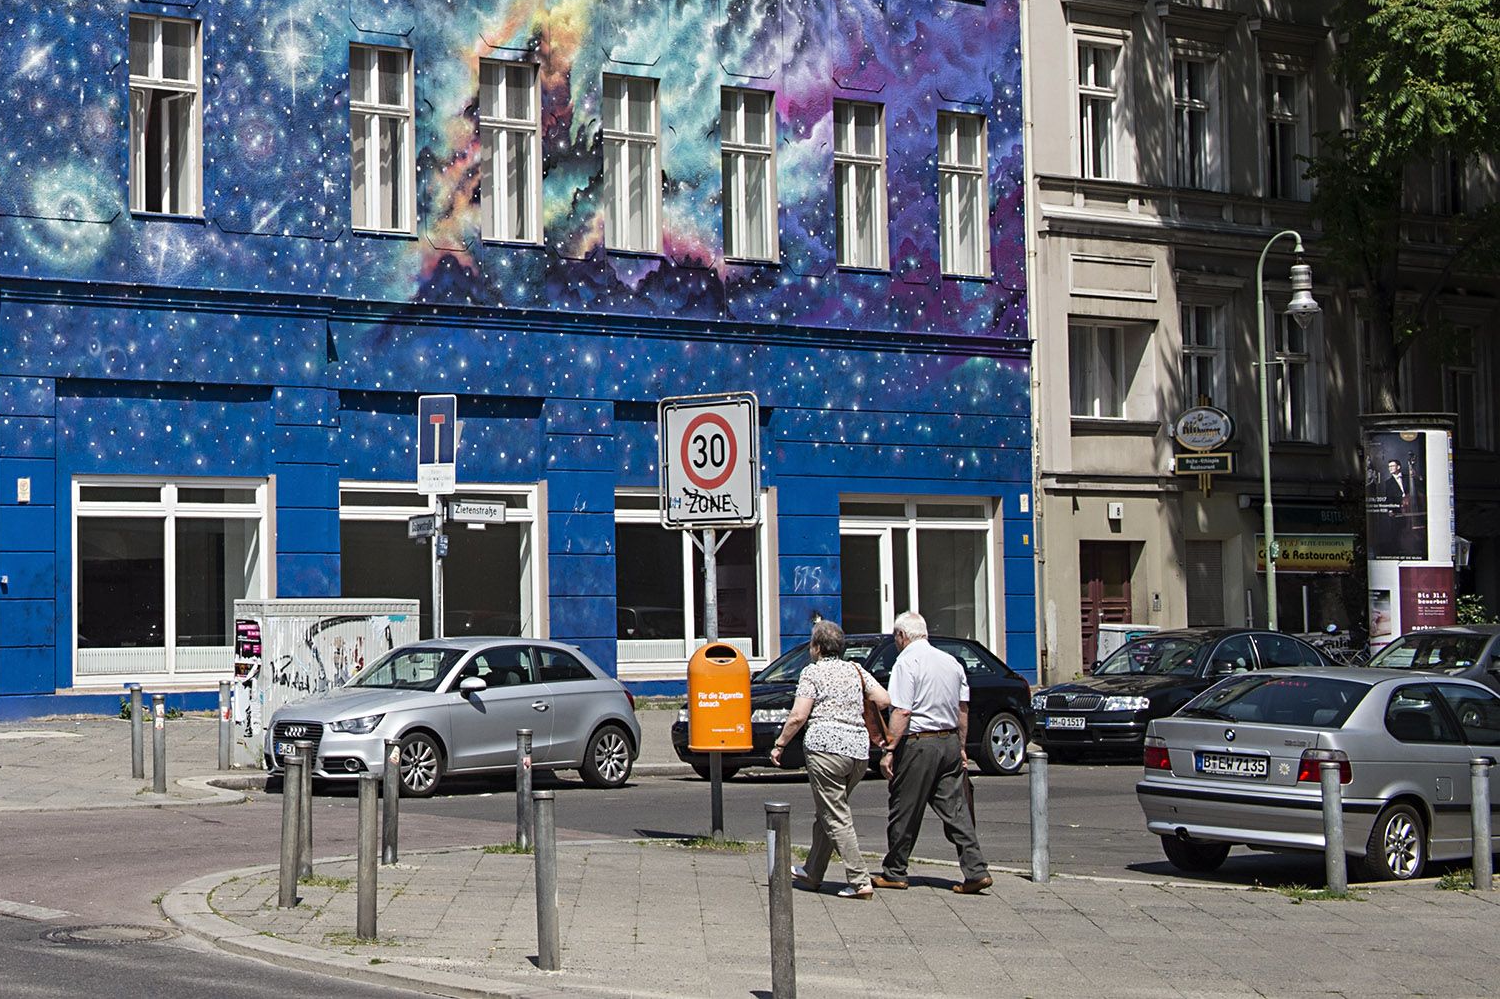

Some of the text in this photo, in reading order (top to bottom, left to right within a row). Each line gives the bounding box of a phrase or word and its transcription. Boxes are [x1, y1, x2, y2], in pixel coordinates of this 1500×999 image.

[692, 433, 725, 469] 30
[455, 503, 498, 517] Zietenstraße
[688, 493, 732, 514] ZONE
[1292, 549, 1345, 561] Restaurant
[697, 691, 744, 701] Für die Zigarette
[698, 700, 720, 708] danach
[1235, 757, 1266, 773] 7135
